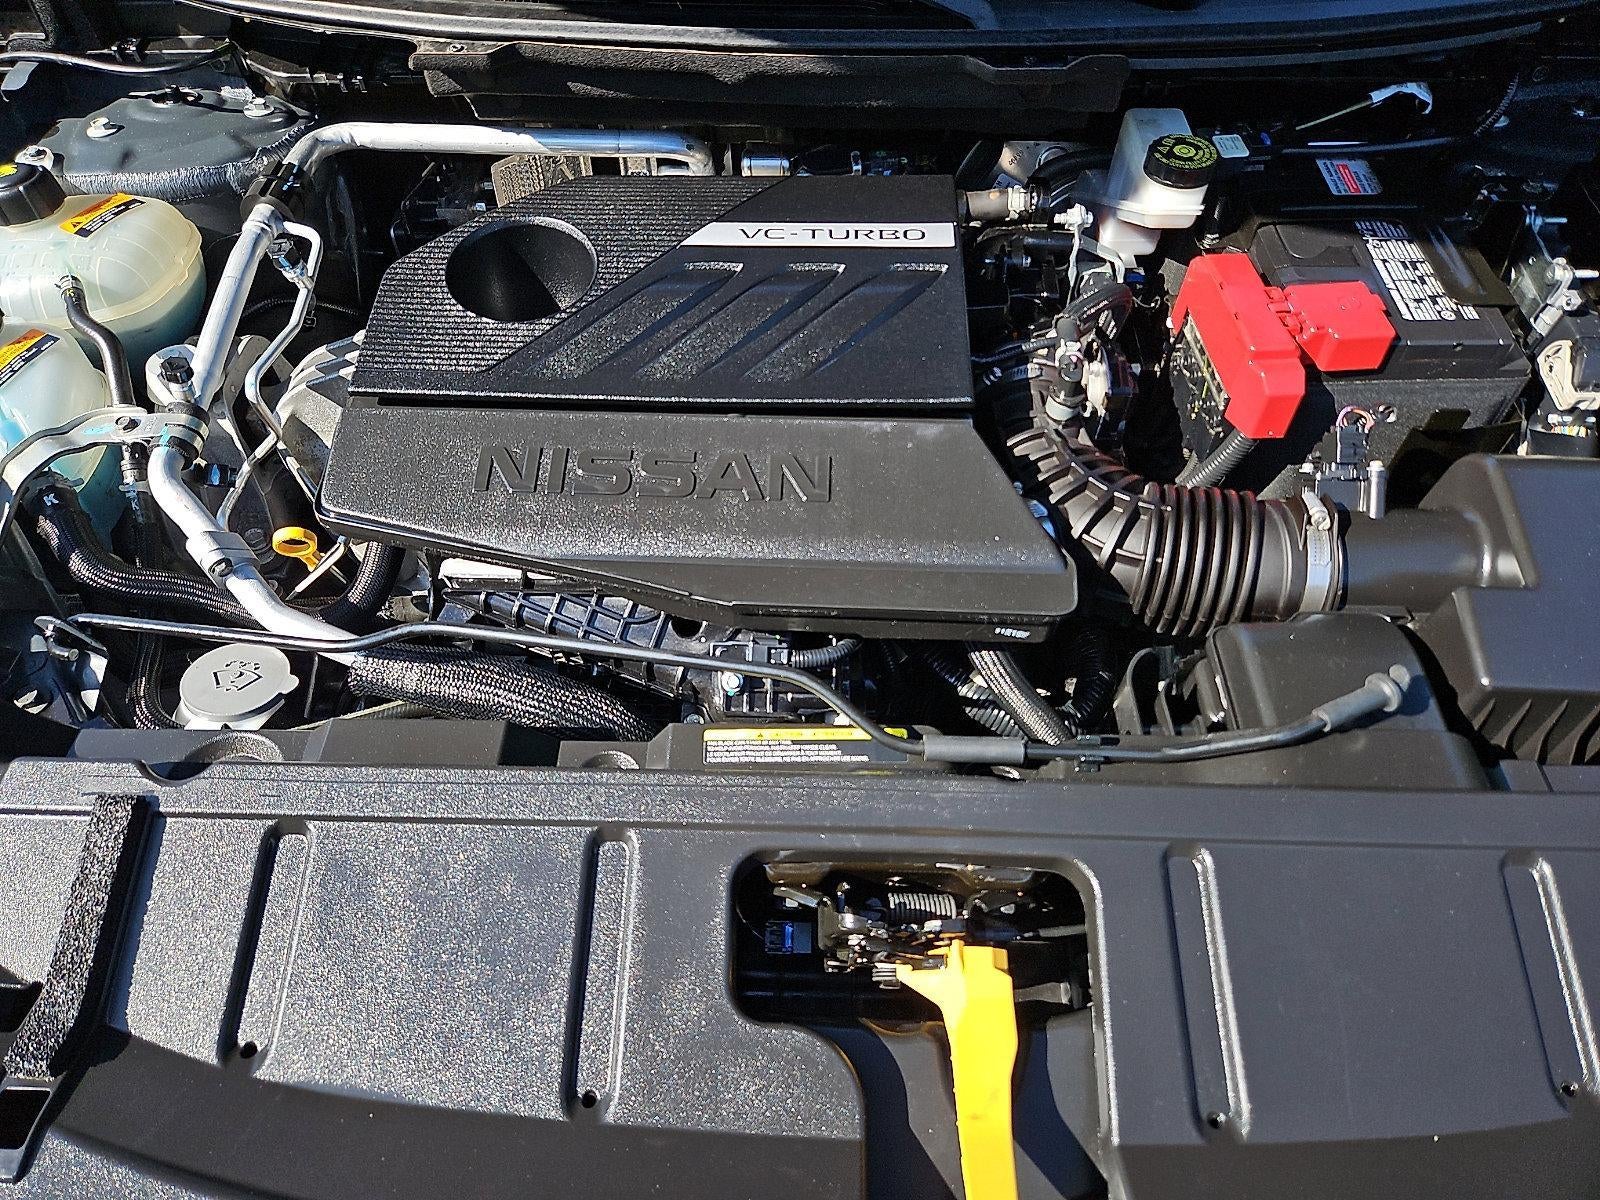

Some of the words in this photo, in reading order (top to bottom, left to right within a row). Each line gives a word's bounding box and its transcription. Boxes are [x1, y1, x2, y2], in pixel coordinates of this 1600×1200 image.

[739, 228, 926, 241] VC-TURBO
[472, 446, 832, 502] NISSAN
[43, 493, 59, 506] K
